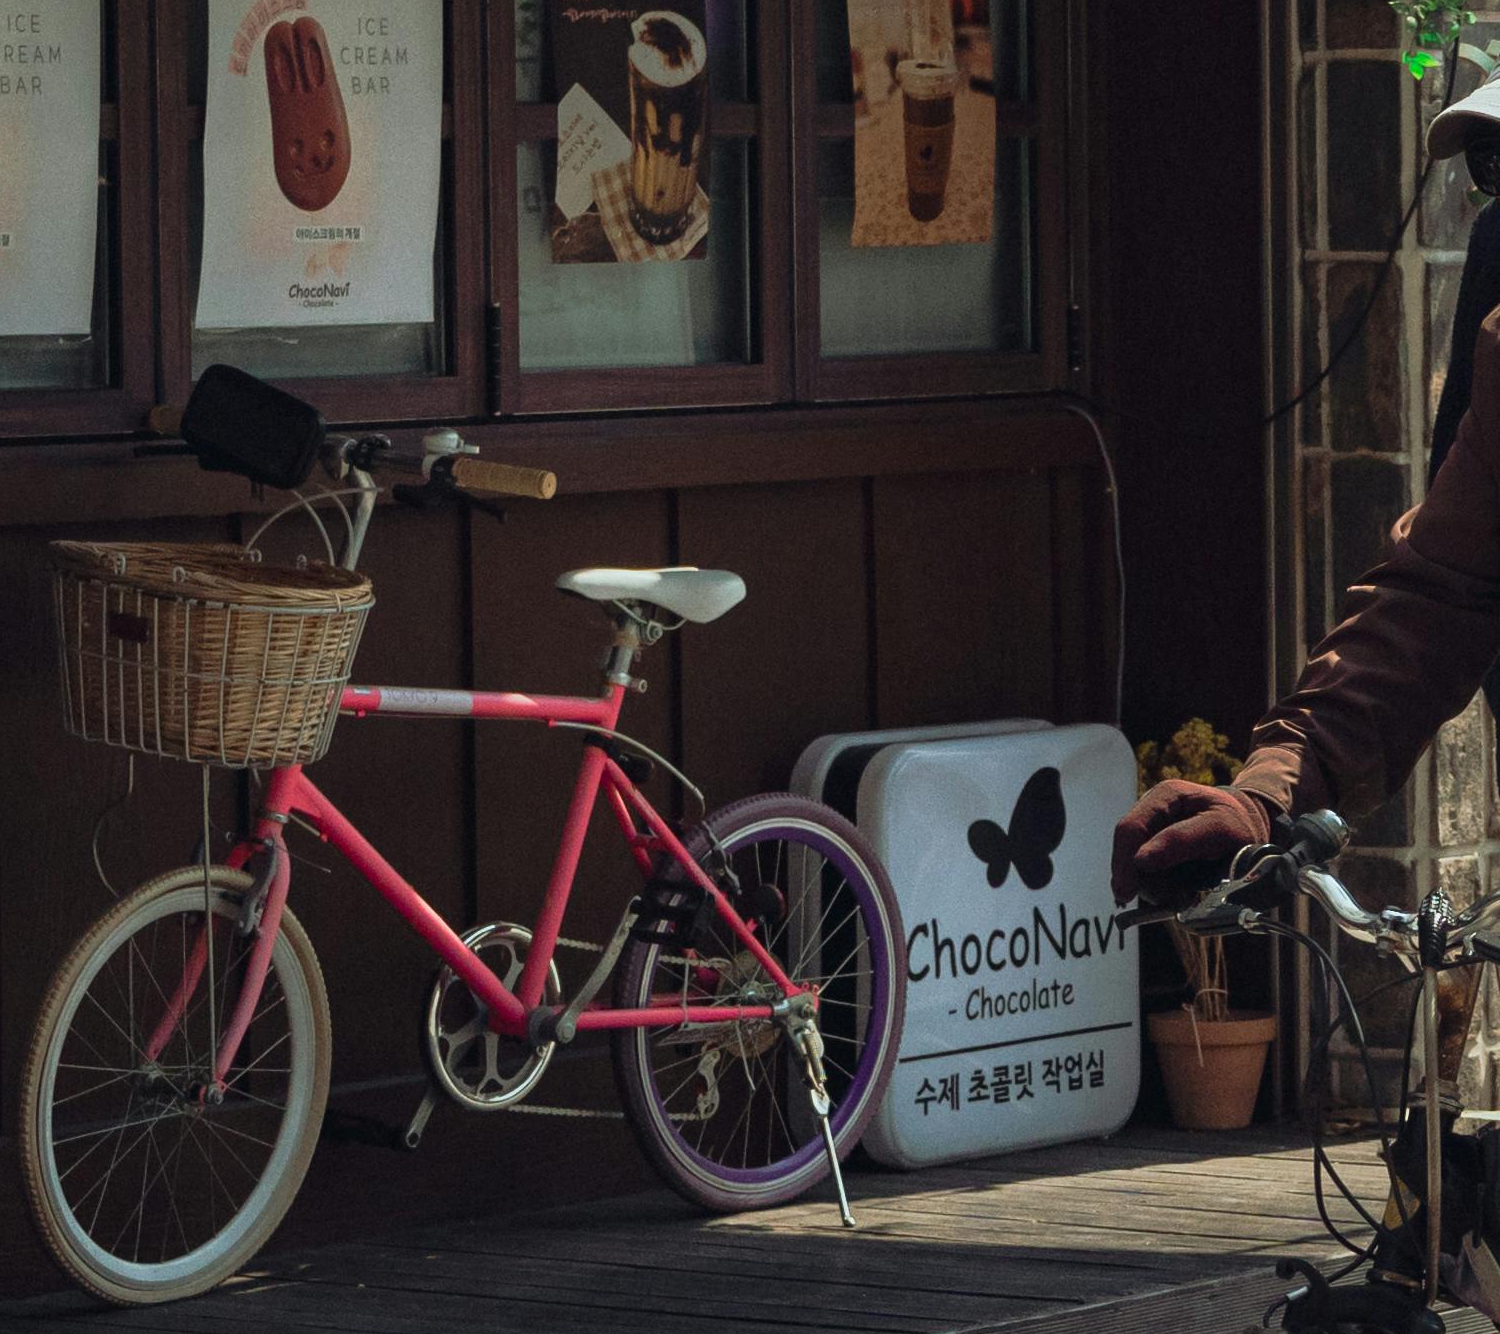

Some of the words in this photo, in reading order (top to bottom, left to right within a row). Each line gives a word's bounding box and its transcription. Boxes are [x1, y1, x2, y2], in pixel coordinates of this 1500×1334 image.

[6, 13, 41, 34] ICE
[357, 17, 389, 36] ICE
[339, 47, 409, 65] CREAM
[0, 75, 43, 95] BAR
[351, 76, 390, 94] BAR
[288, 281, 350, 299] ChocoNavi
[906, 903, 1126, 983] ChocoNavi
[964, 979, 1075, 1021] Chocolate
[914, 1072, 961, 1116] 수제
[966, 1061, 1035, 1107] 초콜릿
[1041, 1050, 1106, 1092] 작업실
